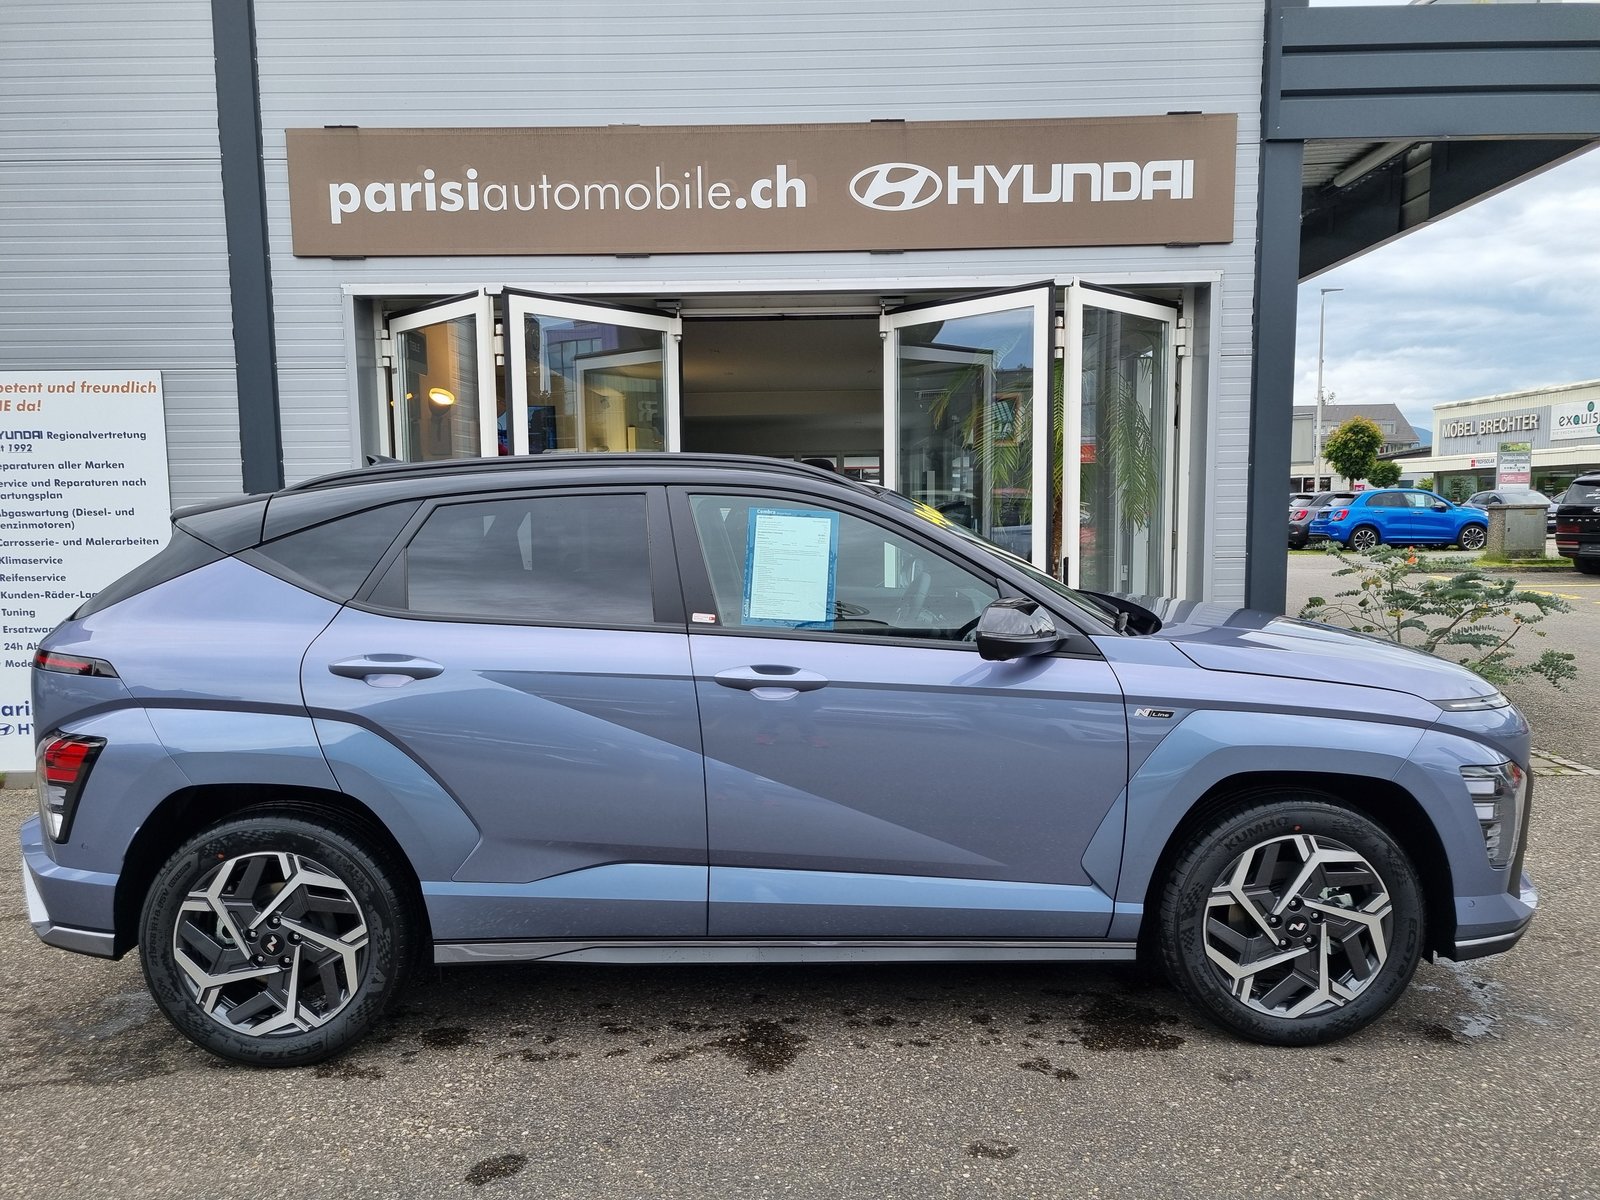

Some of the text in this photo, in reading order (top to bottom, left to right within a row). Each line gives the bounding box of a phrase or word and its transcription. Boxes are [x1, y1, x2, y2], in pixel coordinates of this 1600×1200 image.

[328, 158, 1195, 226] parisiautomobile.ch HYUNDAI
[47, 381, 76, 394] und
[80, 380, 157, 394] freundlich
[16, 399, 42, 412] da!
[1442, 413, 1540, 438] MÖBEL BRECHTER
[46, 431, 147, 442] Regionalvertretung
[8, 443, 33, 453] 1992
[57, 460, 82, 471] aller
[84, 460, 125, 470] Marken
[31, 478, 51, 488] und
[54, 478, 119, 490] Reparaturen
[121, 478, 147, 487] nach
[0, 508, 135, 519] bgaswartung (Diesel- und
[62, 538, 83, 546] und
[86, 537, 159, 547] Malerarbeiten
[0, 556, 63, 565] Klimaservice
[0, 573, 67, 582] Reifenservice
[1, 608, 36, 619] Tuning
[4, 642, 23, 651] 24h
[18, 723, 34, 735] H
[1222, 816, 1289, 851] KUMHO
